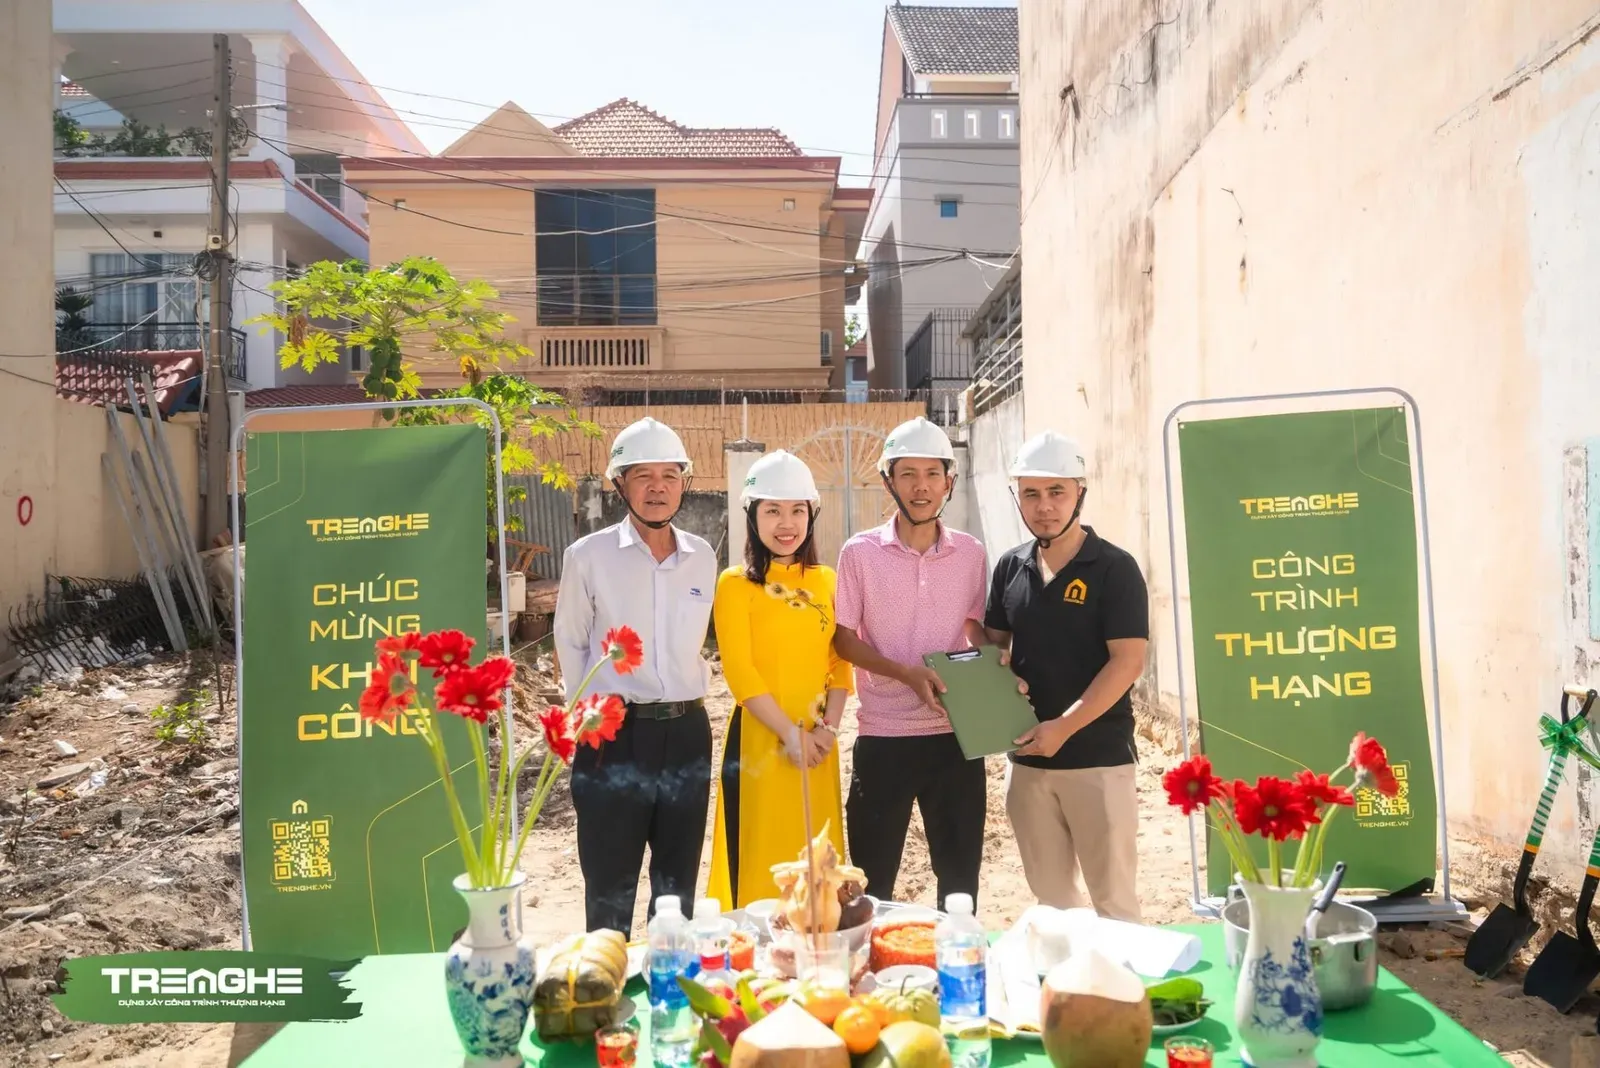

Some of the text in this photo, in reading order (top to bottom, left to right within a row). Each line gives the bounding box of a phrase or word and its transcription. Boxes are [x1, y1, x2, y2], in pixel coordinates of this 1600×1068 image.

[1252, 551, 1355, 579] CÔNG
[313, 573, 418, 606] CHÚC
[1251, 583, 1358, 612] TRÌNH
[310, 610, 420, 642] MỪNG
[1215, 624, 1396, 661] THƯỢNG
[311, 659, 418, 691] KHI
[1250, 671, 1371, 707] HẠNG
[1358, 820, 1409, 828] TRENGHE.VN
[277, 884, 332, 892] TRENGHE.VN
